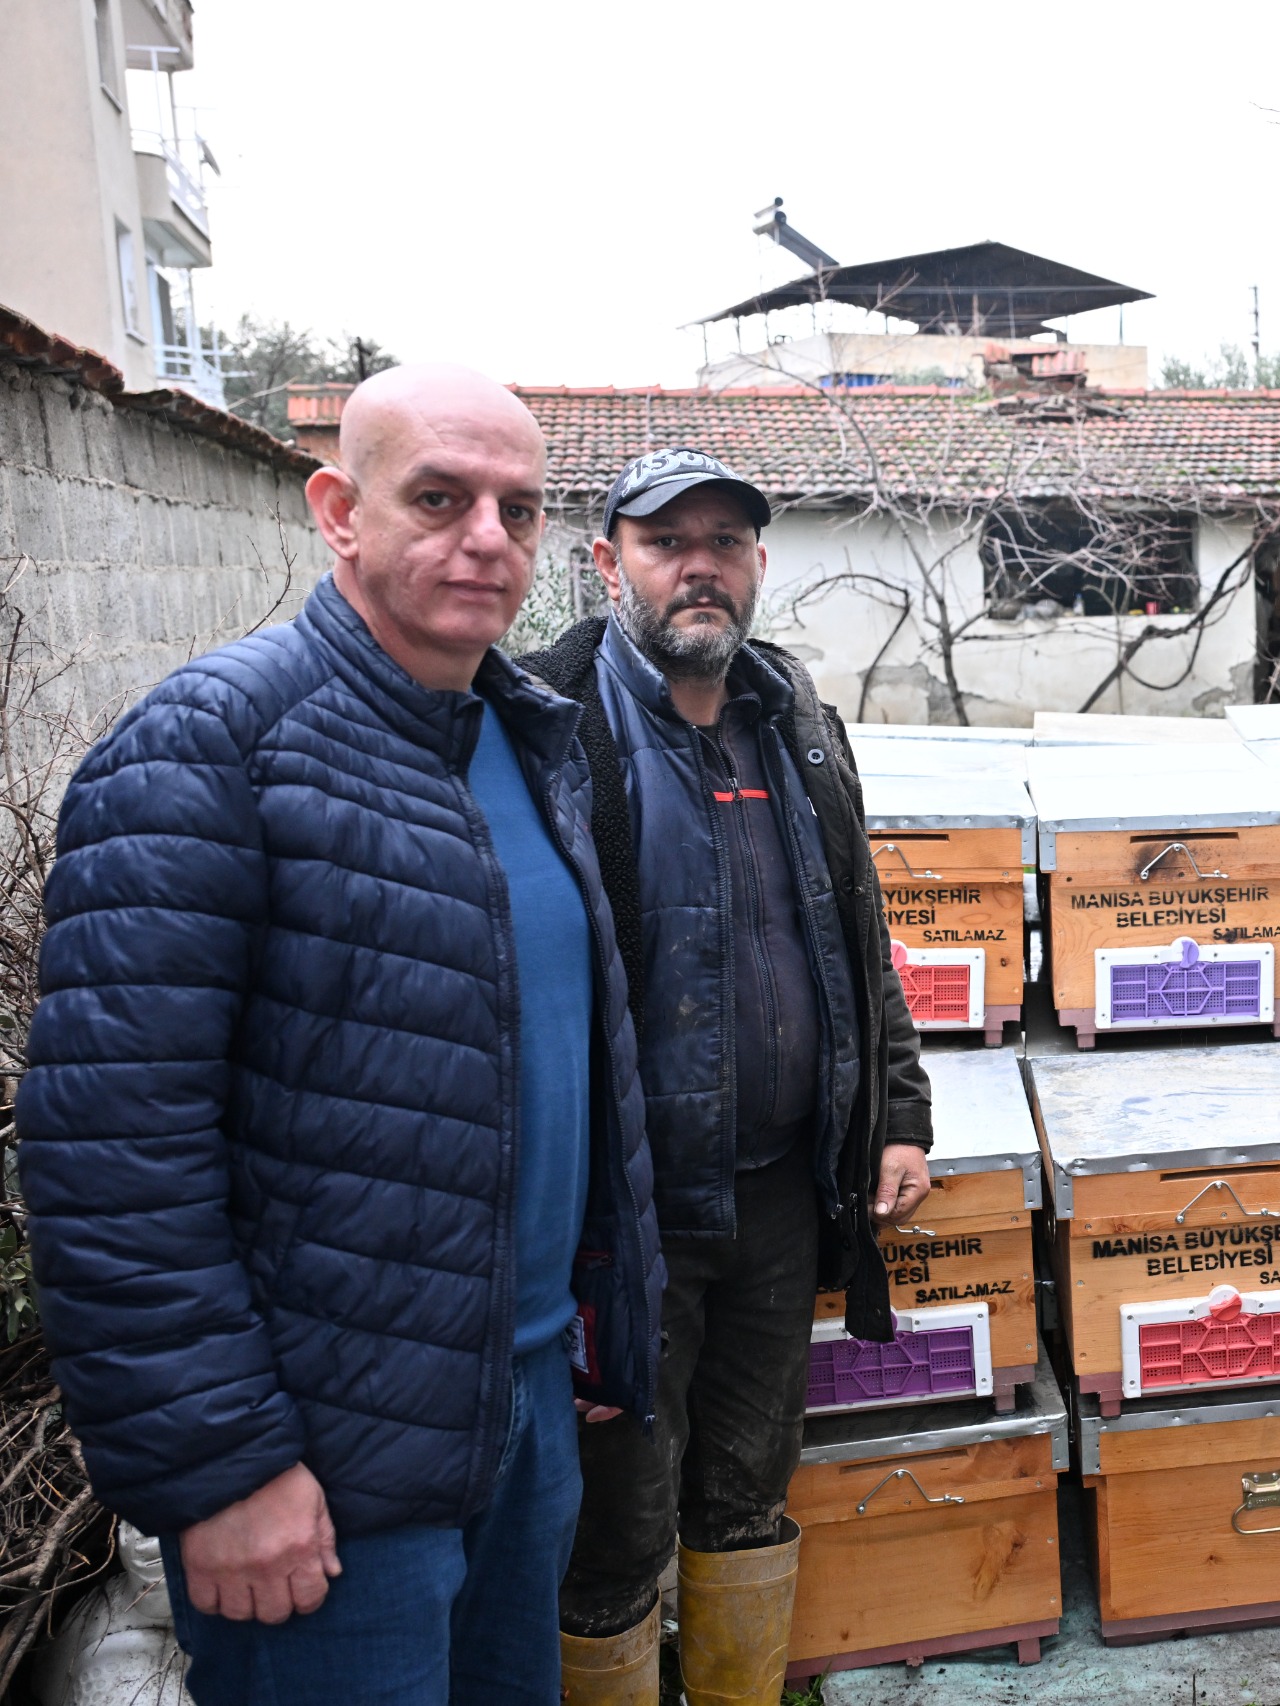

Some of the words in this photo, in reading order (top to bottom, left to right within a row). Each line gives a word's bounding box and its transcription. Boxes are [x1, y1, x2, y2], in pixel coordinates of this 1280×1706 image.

[881, 886, 981, 906] YÜKŞEHİR
[882, 906, 935, 925] İYESİ
[923, 929, 1006, 943] SATILAMAZ
[880, 1235, 983, 1263] ÜKŞEHİR
[1092, 1232, 1180, 1259] MANİSA
[1147, 1246, 1273, 1276] BELEDİYESİ
[915, 1280, 1015, 1303] SATILAMAZ
